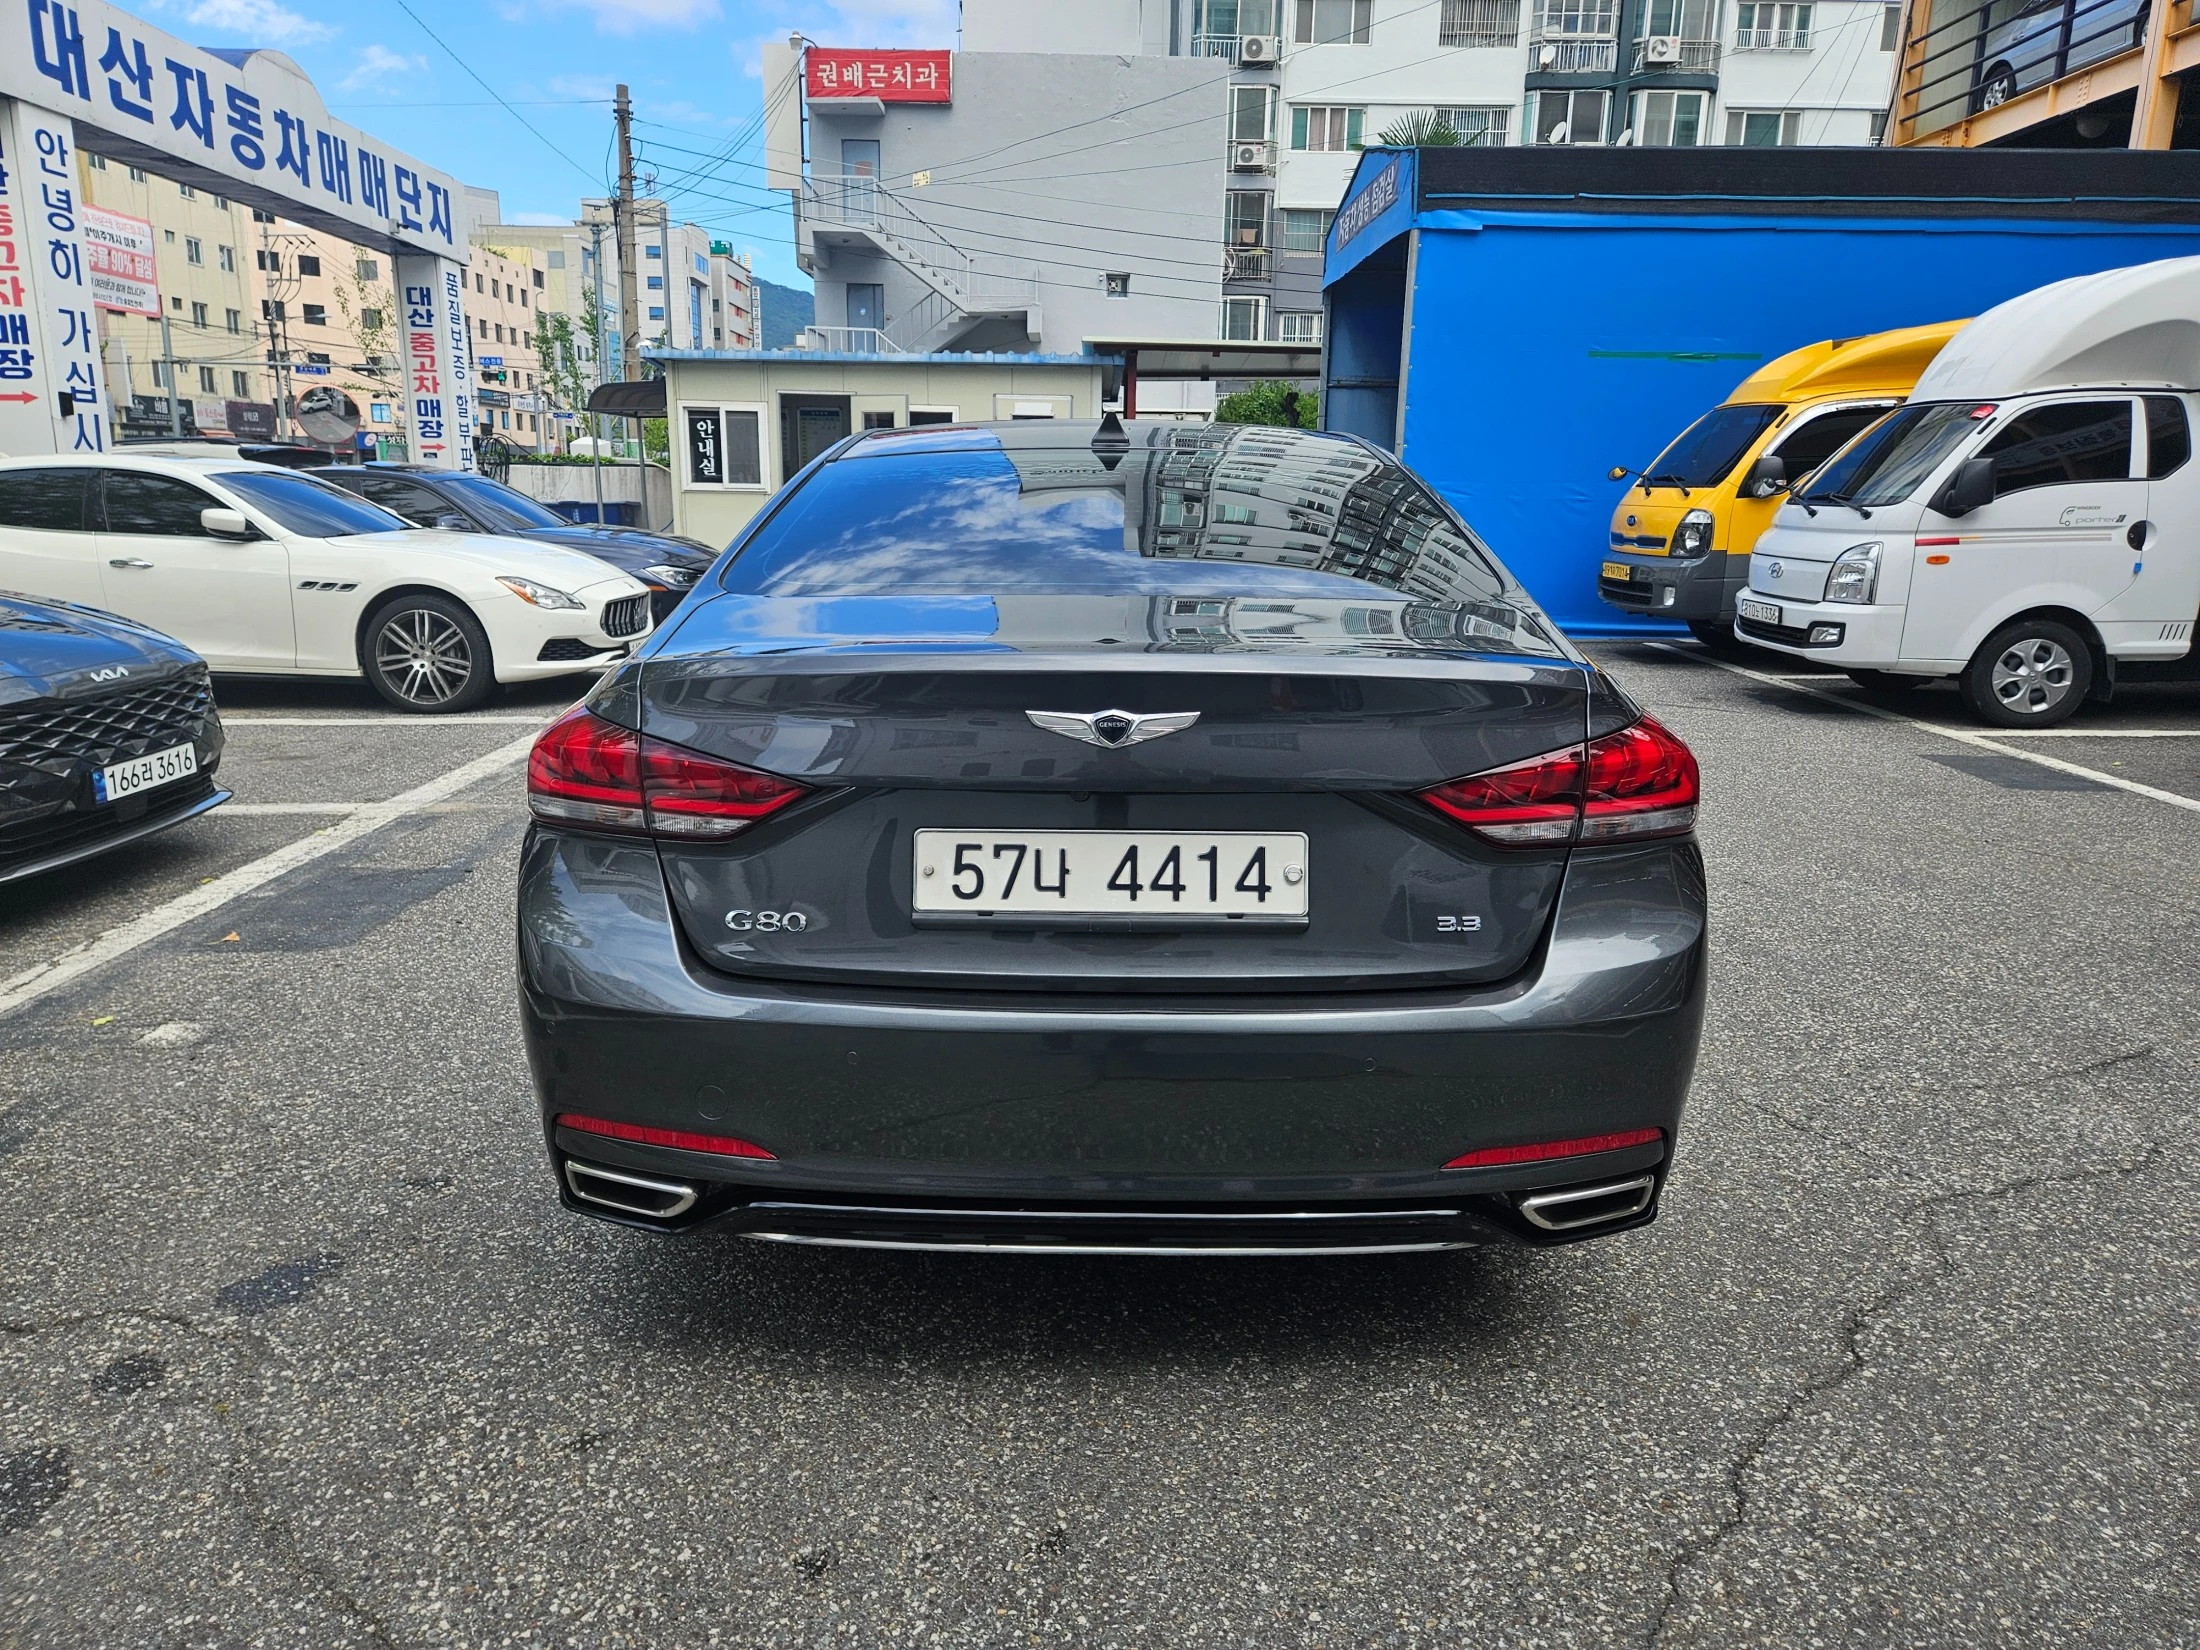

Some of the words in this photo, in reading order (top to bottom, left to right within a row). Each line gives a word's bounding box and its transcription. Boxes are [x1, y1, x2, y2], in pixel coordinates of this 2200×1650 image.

[817, 61, 939, 90] 권배근치과
[28, 0, 452, 246] 대산자동차매매단지
[34, 128, 83, 286] 안녕히
[696, 419, 716, 476] 안내실
[109, 761, 153, 794] 166러
[156, 748, 193, 780] 3616
[951, 843, 1072, 900] 57나
[1106, 844, 1273, 902] 4414
[725, 909, 807, 932] G80
[1437, 916, 1481, 931] 3.3
